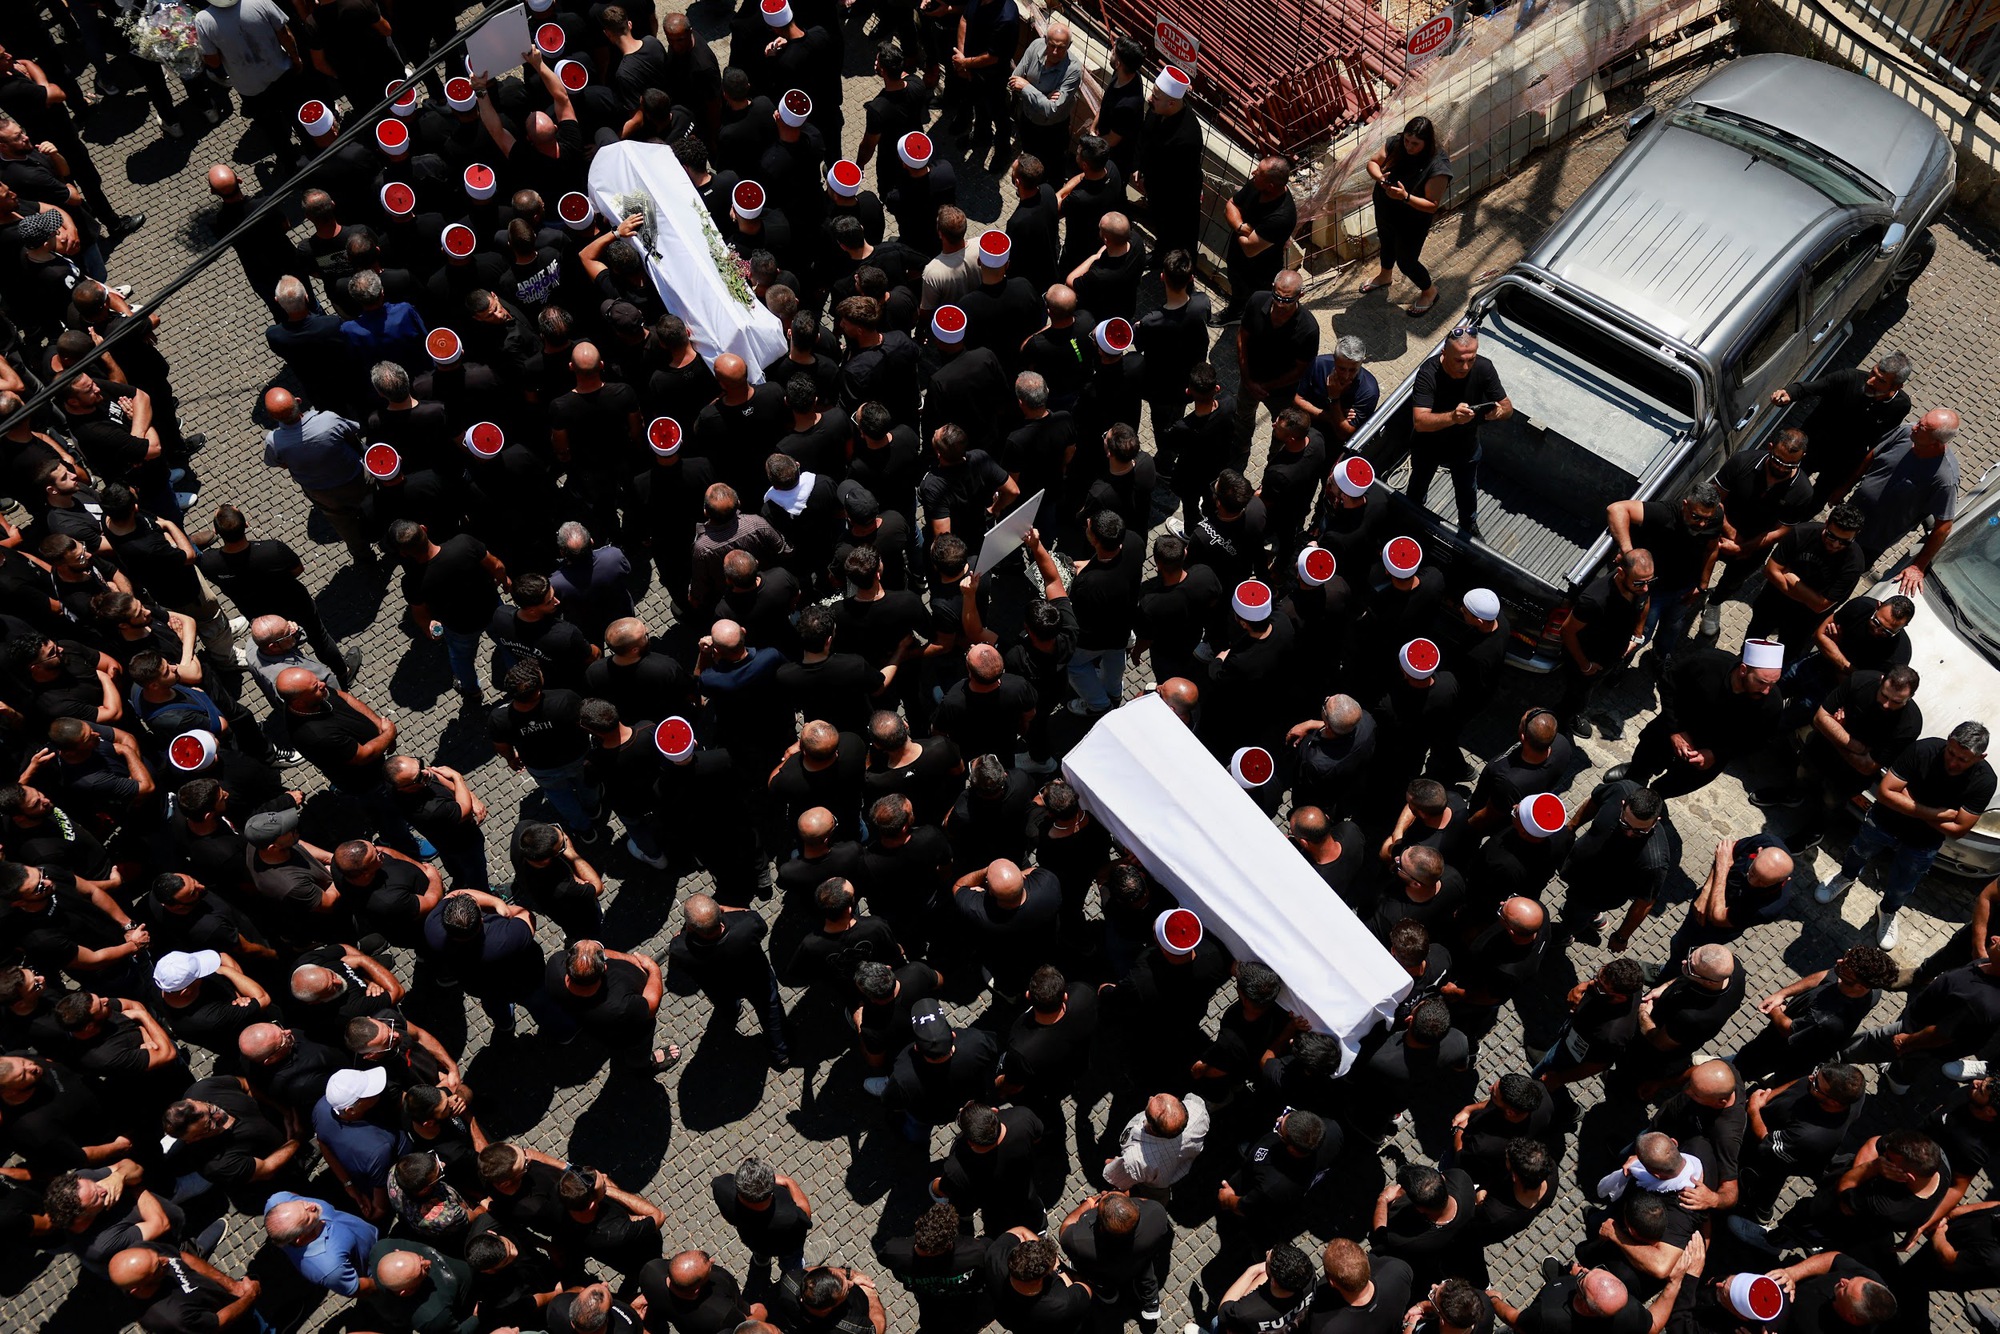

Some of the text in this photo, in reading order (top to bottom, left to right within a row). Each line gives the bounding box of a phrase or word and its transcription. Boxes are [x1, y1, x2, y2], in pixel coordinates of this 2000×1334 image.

[1164, 25, 1190, 52] סכנה
[1416, 18, 1445, 44] סכנה
[1434, 31, 1447, 45] כאן
[1160, 36, 1177, 52] בונים
[1413, 39, 1433, 54] בונים
[1177, 48, 1191, 61] כאן
[1197, 516, 1238, 556] hampion
[519, 720, 553, 736] FAITH
[1258, 1289, 1316, 1331] FUTUR
